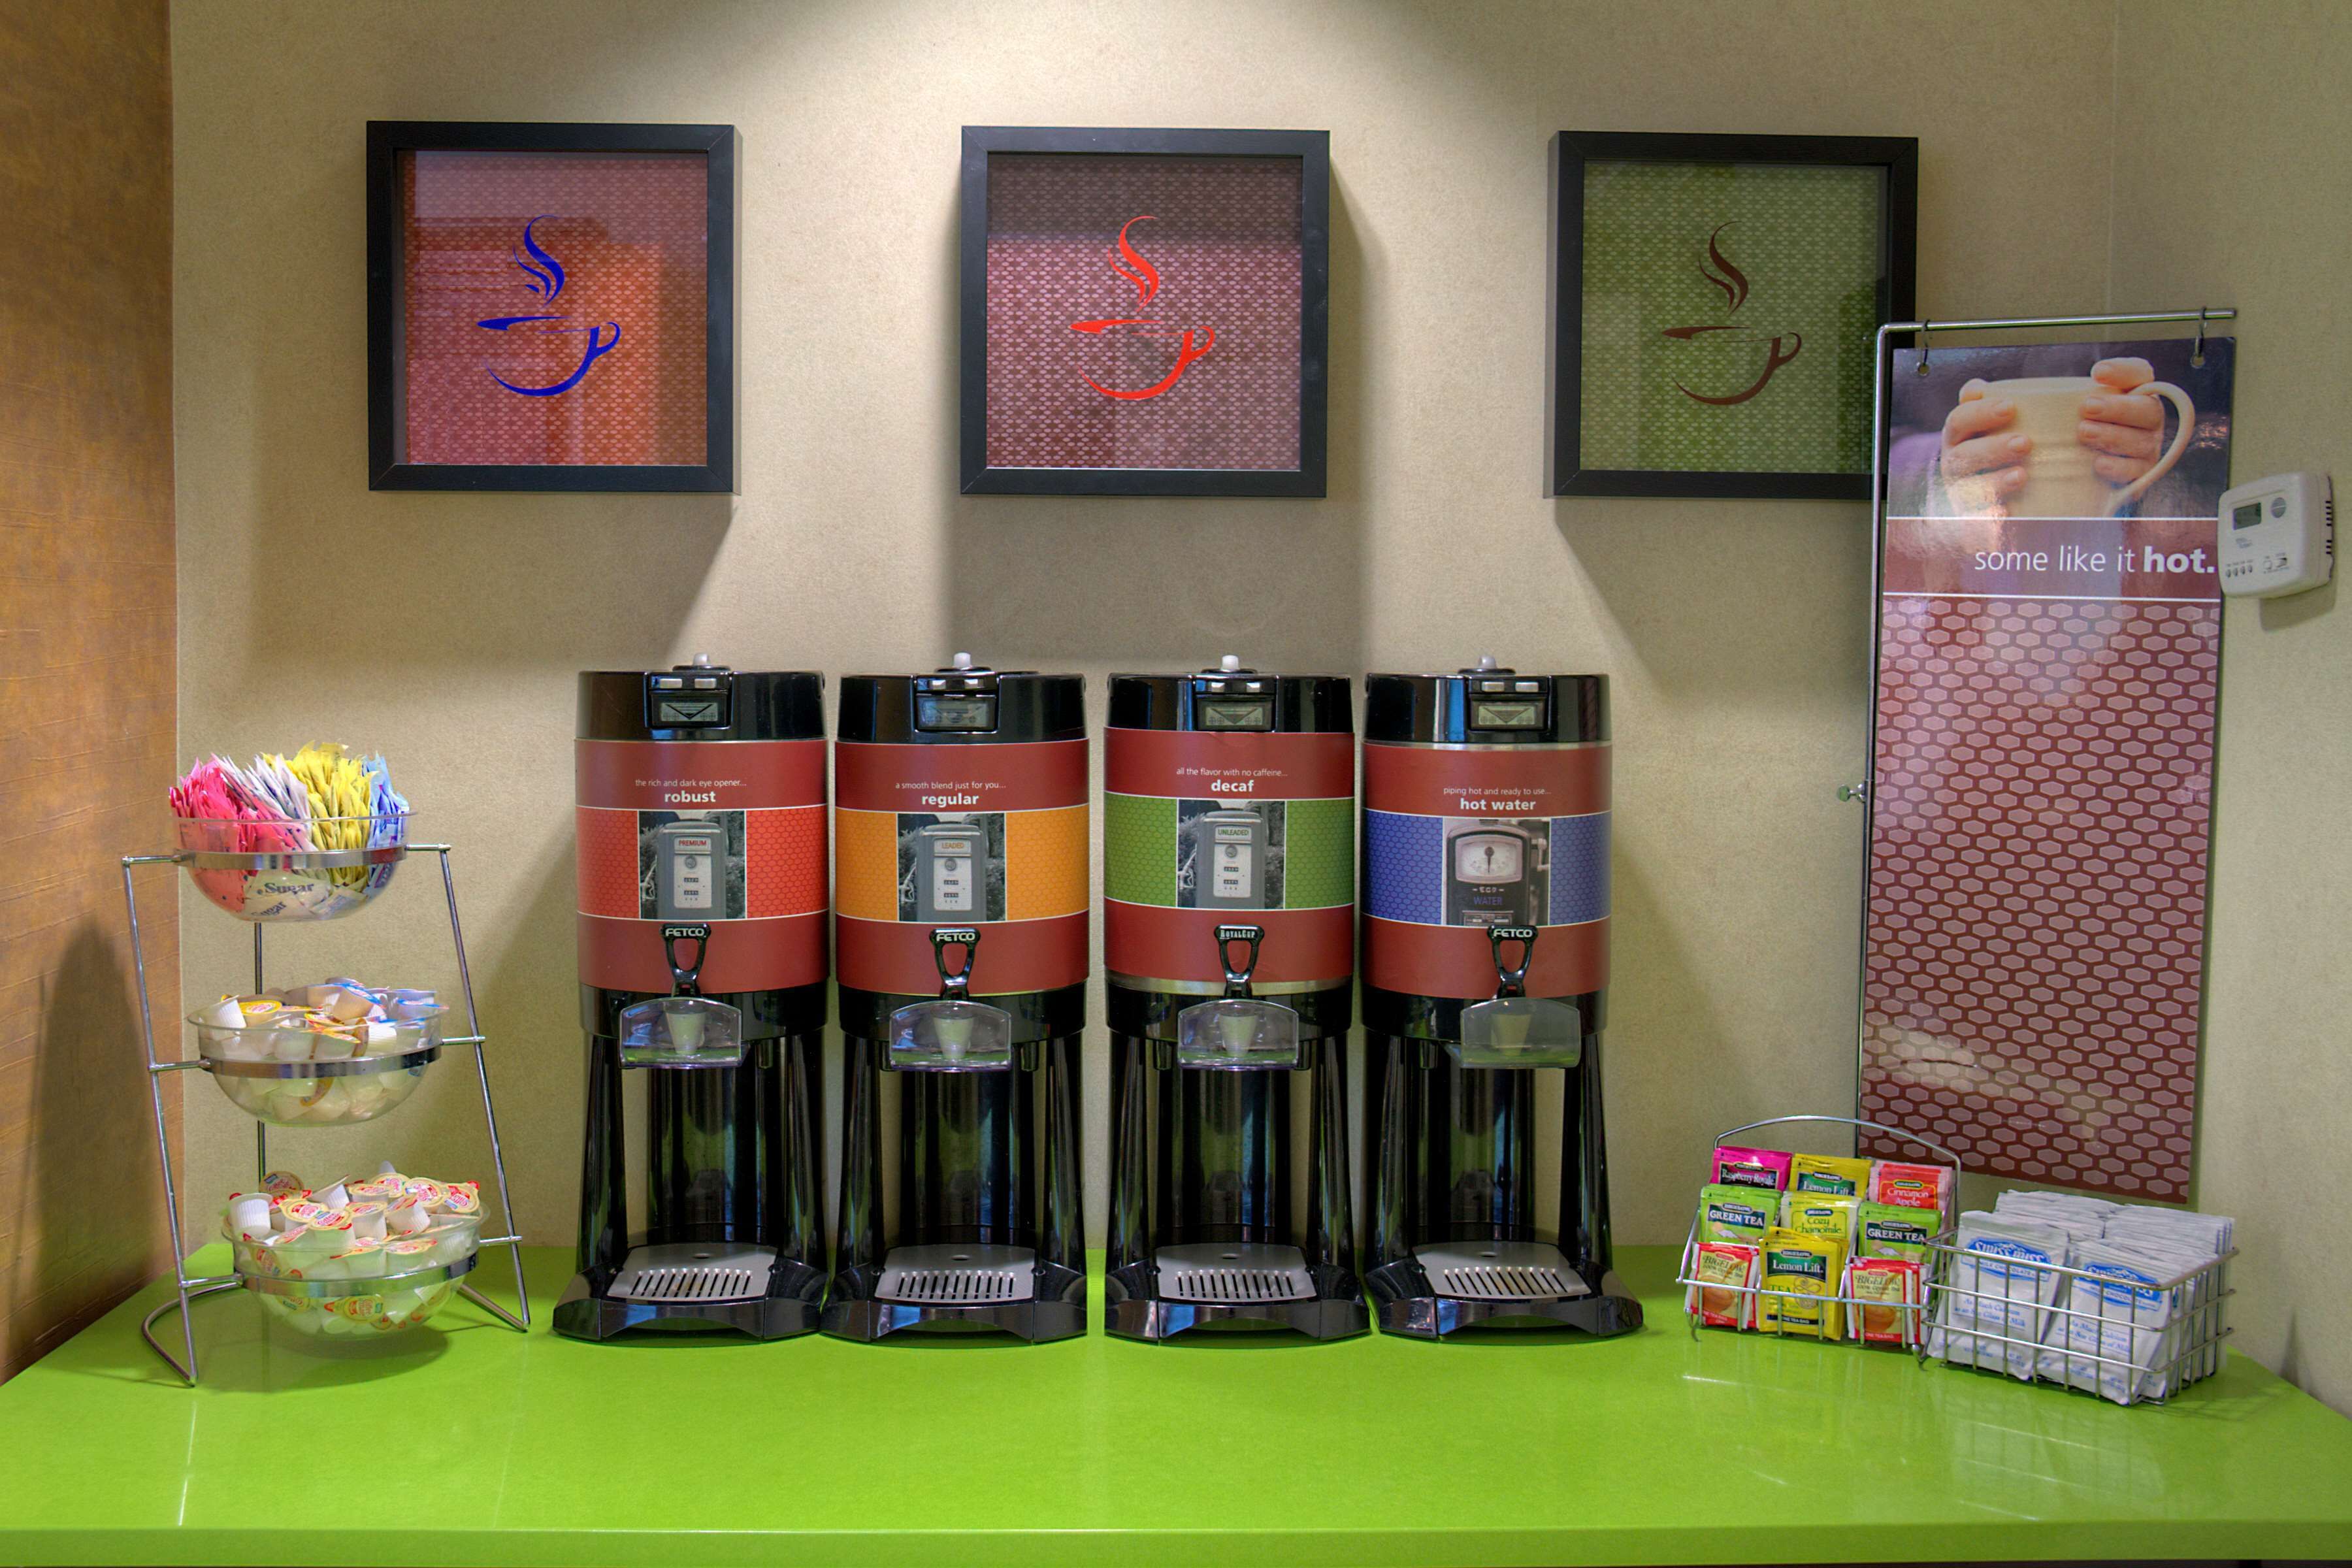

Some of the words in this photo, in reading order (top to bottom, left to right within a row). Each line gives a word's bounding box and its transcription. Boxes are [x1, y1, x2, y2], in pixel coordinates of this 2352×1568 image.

[1974, 551, 2048, 571] some
[2059, 545, 2106, 572] like
[2117, 546, 2135, 572] it
[2144, 546, 2215, 573] hot.
[955, 782, 969, 791] just
[1211, 779, 1254, 792] decaf
[664, 790, 716, 802] robust
[1443, 787, 1466, 796] piping
[1501, 787, 1521, 796] ready
[922, 792, 979, 808] regular
[1460, 798, 1487, 810] hot
[1492, 798, 1536, 810] water
[264, 882, 314, 895] Sugar
[1474, 896, 1503, 906] WATER
[665, 928, 704, 938] FETCO
[936, 933, 975, 941] FETCO
[1494, 928, 1533, 938] FETCO
[1803, 1181, 1832, 1194] Lemon
[1887, 1187, 1929, 1198] Cinnamon
[1896, 1198, 1921, 1207] Apple
[1709, 1210, 1742, 1222] GREEN
[1744, 1215, 1763, 1226] TEA
[1807, 1217, 1830, 1226] Cozy
[1867, 1228, 1903, 1240] GREEN
[1904, 1232, 1925, 1241] TEA
[1772, 1260, 1802, 1270] Lemon
